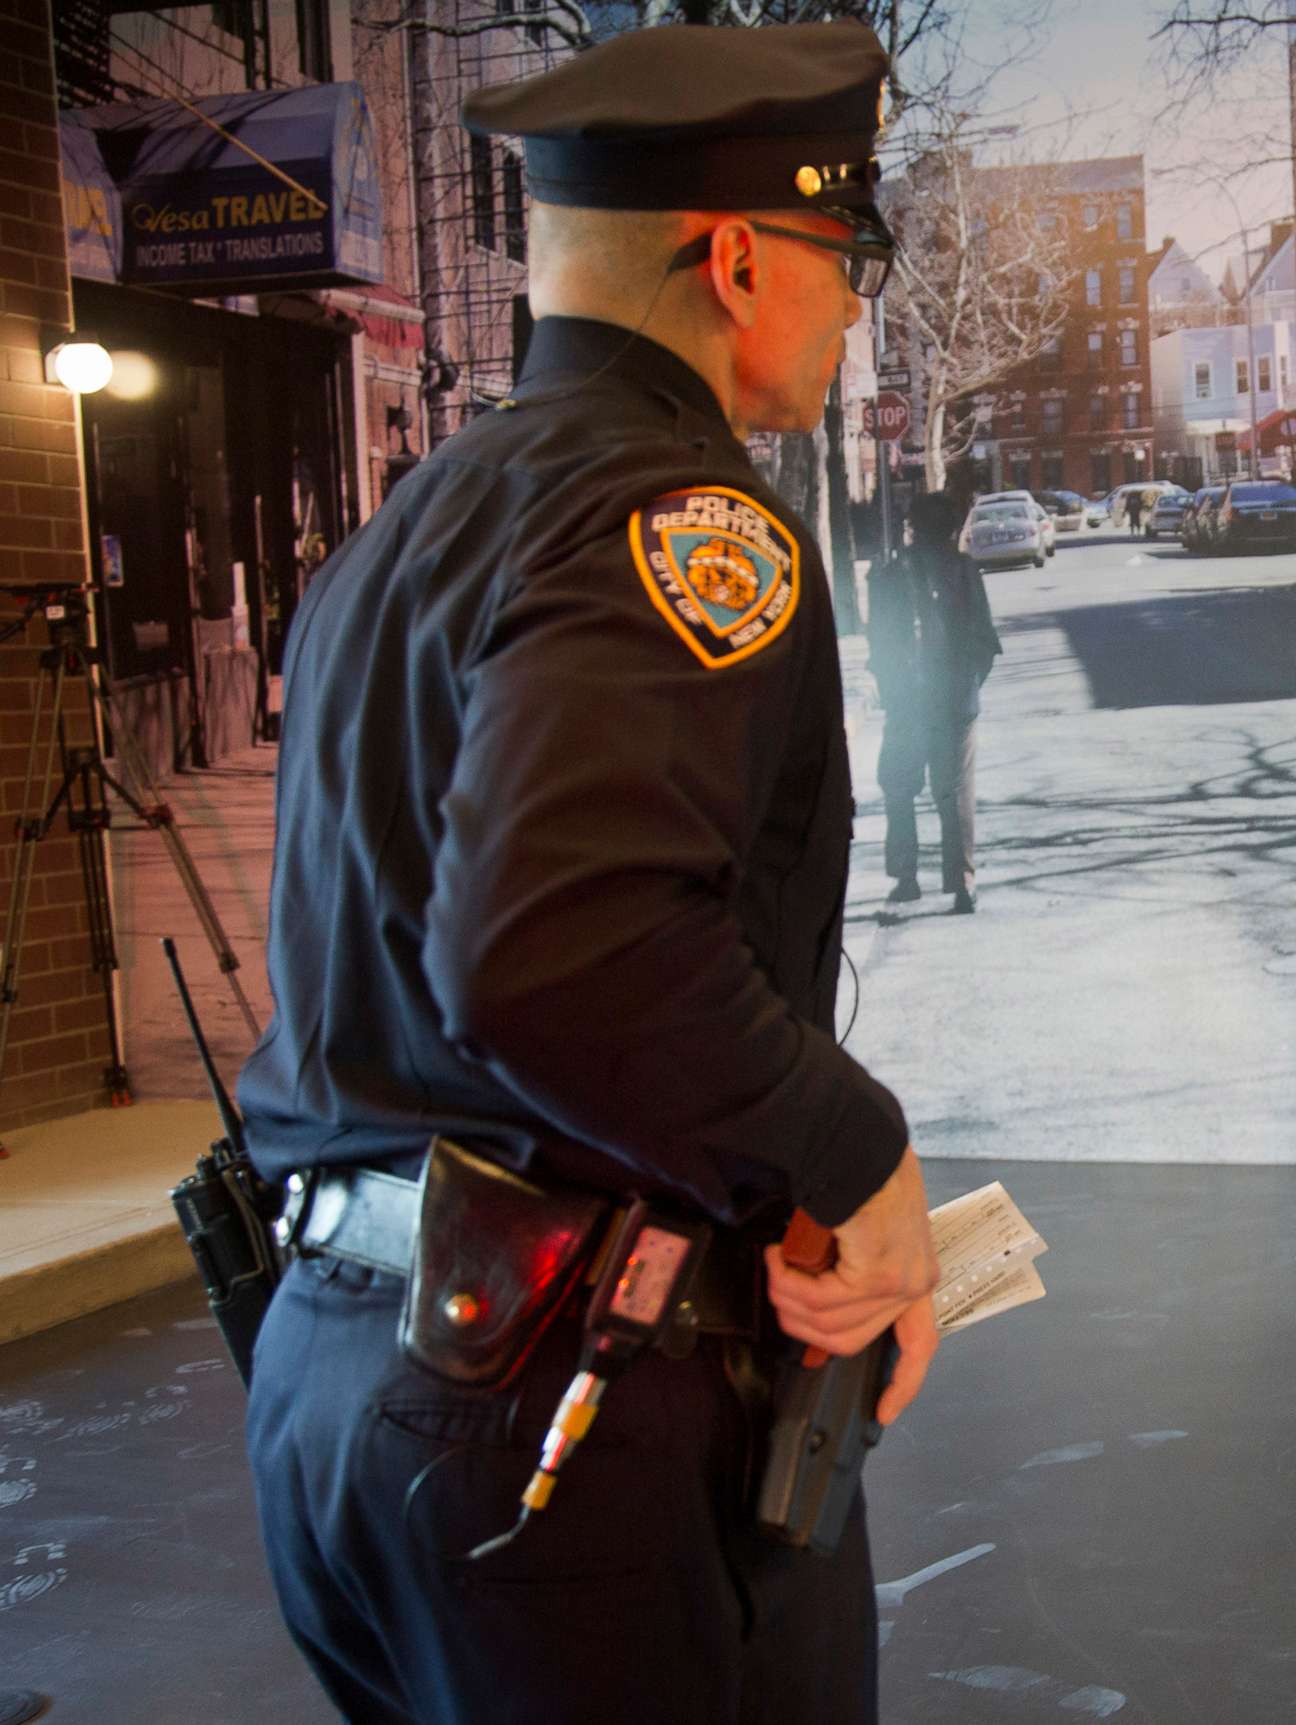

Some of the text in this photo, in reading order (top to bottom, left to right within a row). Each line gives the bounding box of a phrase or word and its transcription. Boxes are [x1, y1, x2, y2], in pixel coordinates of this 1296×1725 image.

[212, 189, 324, 229] TRAVEL
[136, 243, 186, 267] INCOME
[190, 241, 216, 264] TAX
[225, 232, 325, 263] TRANSLATIONS
[686, 496, 769, 533] POLICE
[652, 511, 791, 571] DEPARTMENT
[650, 551, 683, 594] CITY
